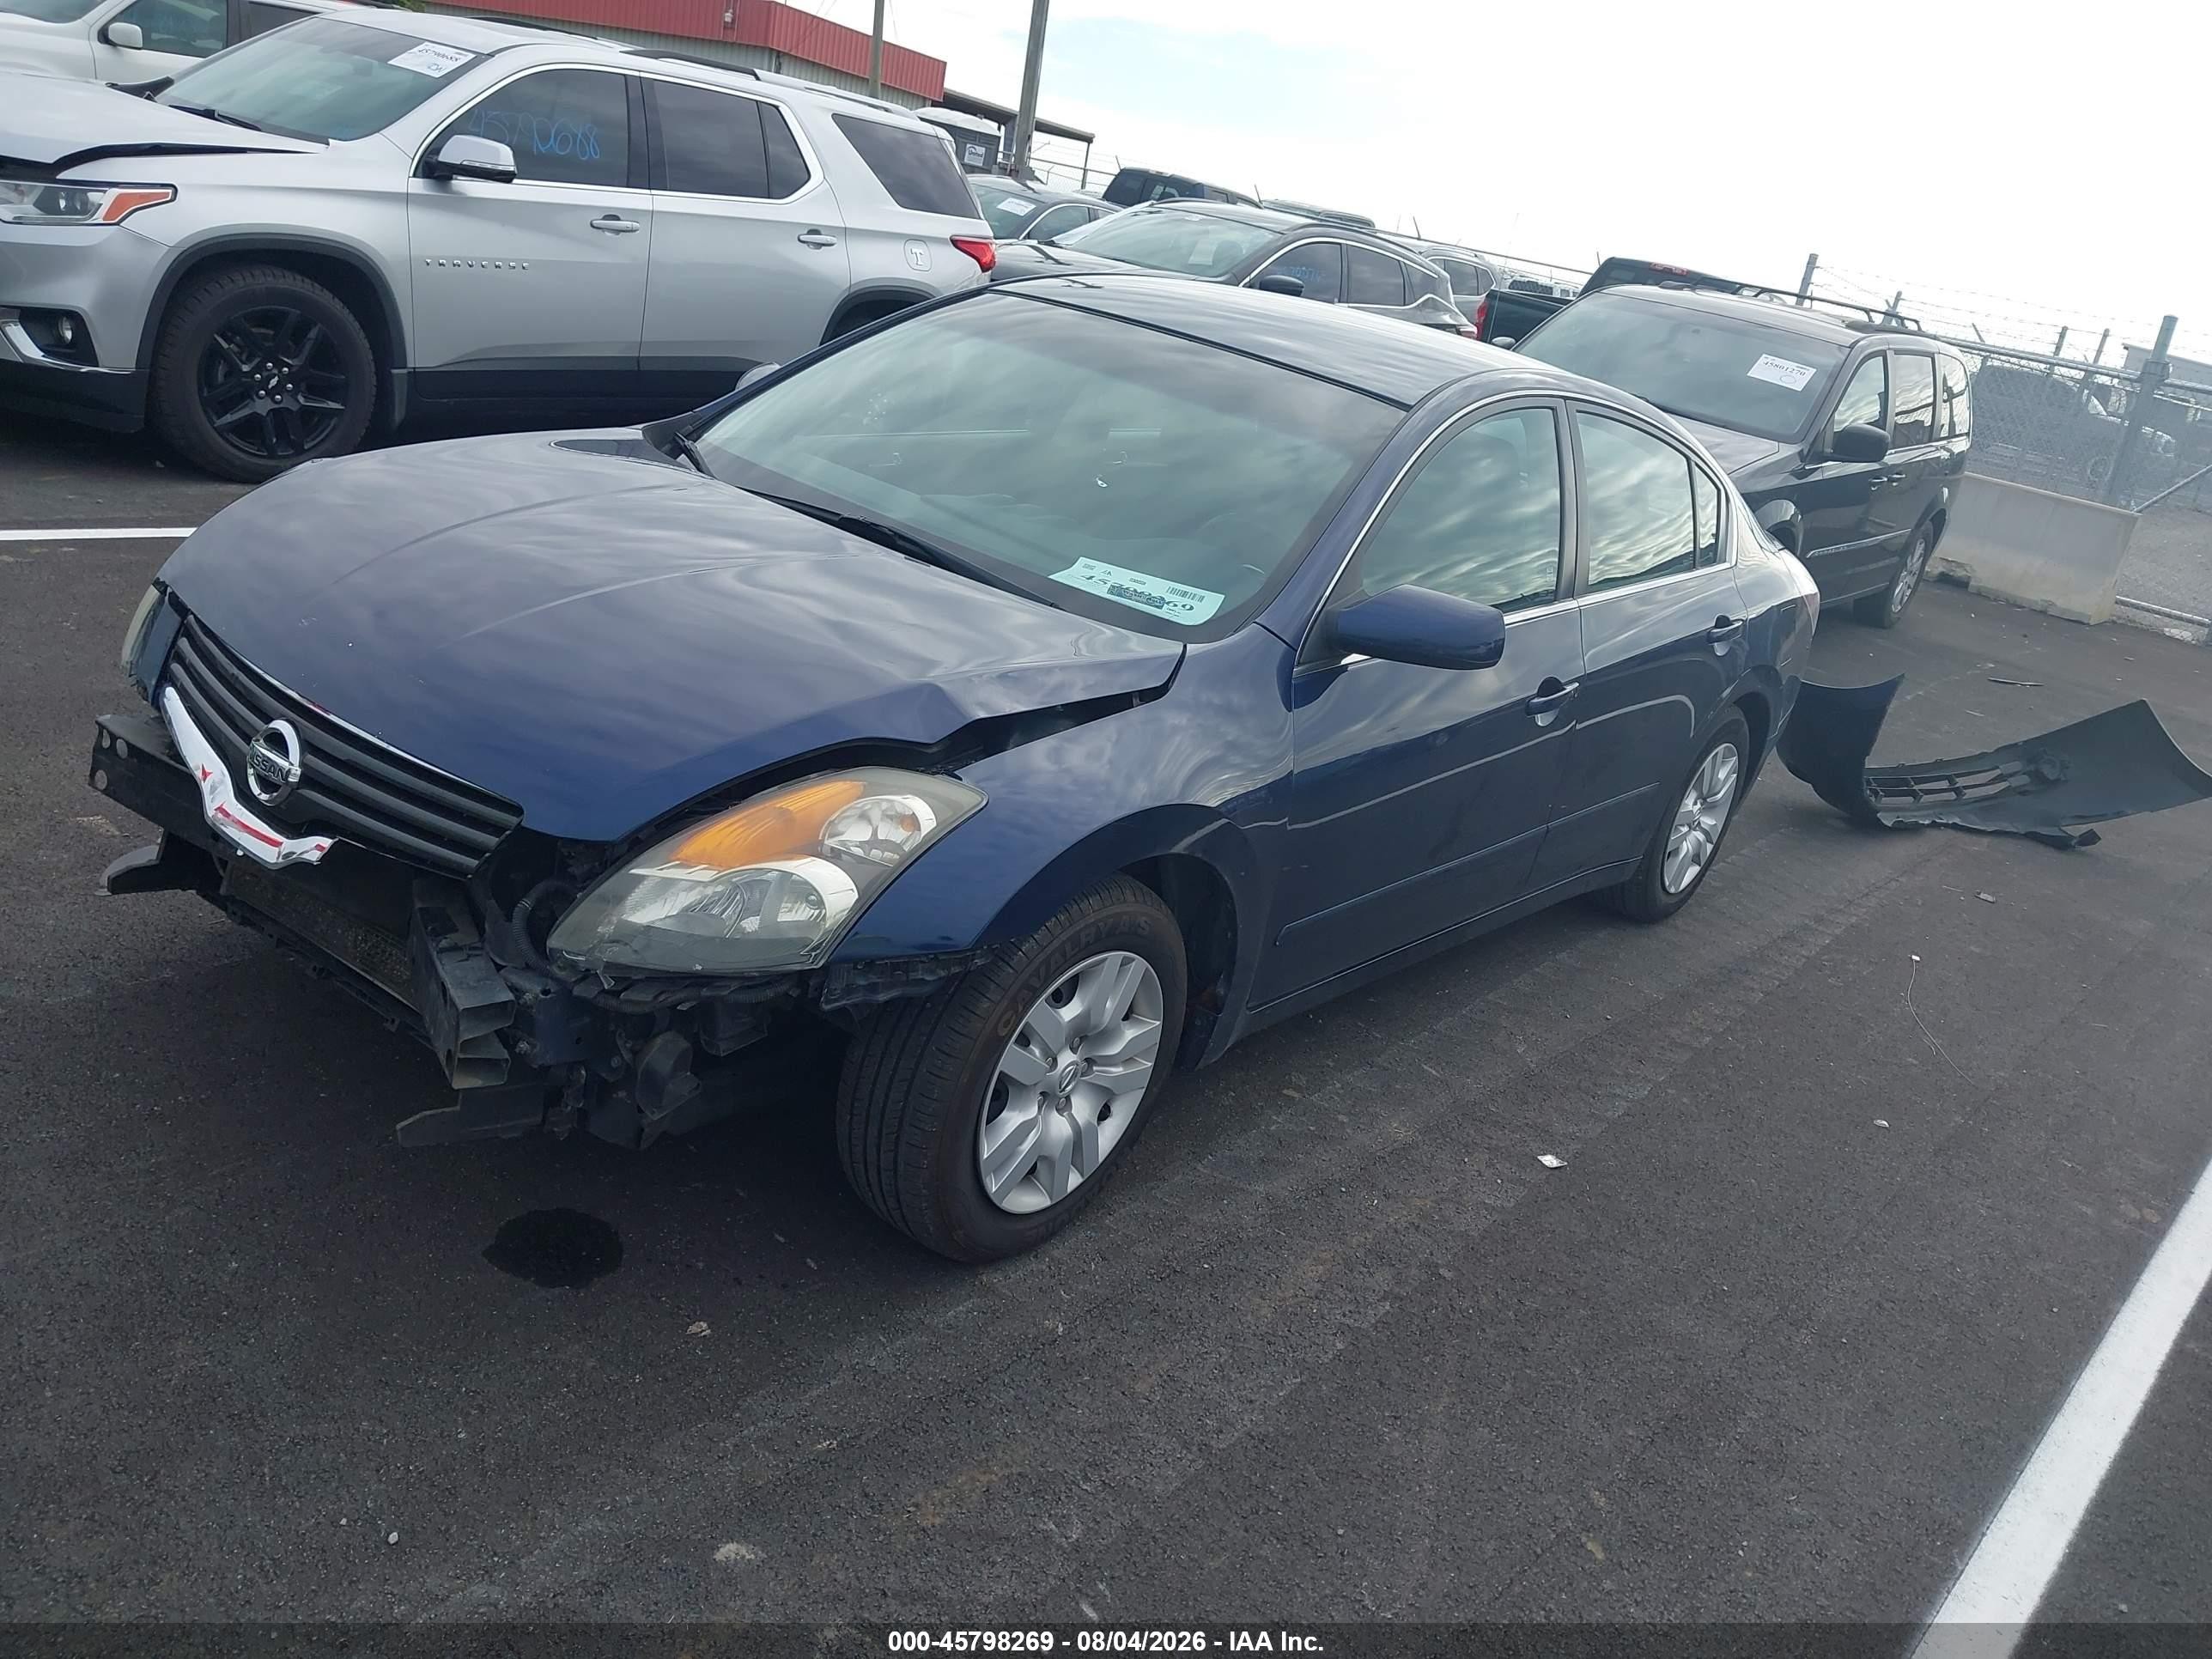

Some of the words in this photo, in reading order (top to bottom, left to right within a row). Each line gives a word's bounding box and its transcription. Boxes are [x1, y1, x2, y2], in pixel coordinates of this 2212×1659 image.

[424, 258, 530, 270] TRAVERSE
[1762, 360, 1807, 377] 45801270
[997, 917, 1114, 1036] CAVALRY
